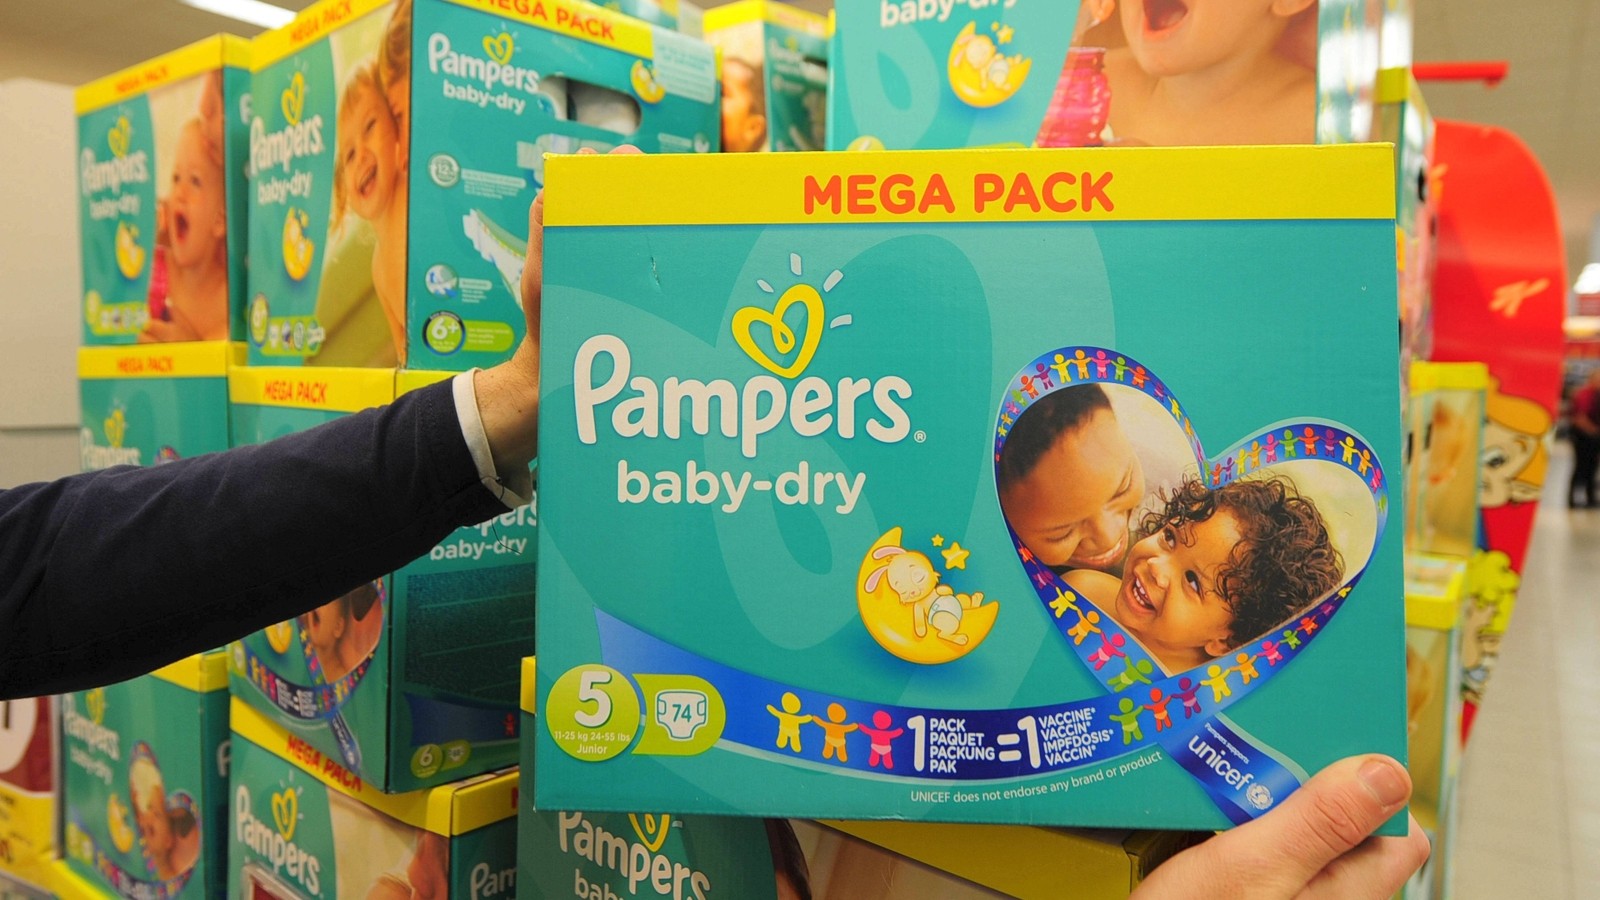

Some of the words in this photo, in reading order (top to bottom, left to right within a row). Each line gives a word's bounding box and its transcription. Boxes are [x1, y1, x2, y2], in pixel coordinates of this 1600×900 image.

[476, 0, 548, 21] EGA
[556, 8, 615, 41] PACK
[428, 32, 539, 94] Pampers
[443, 79, 525, 115] baby-dry
[250, 116, 323, 175] Pampers
[803, 173, 956, 215] MEGA
[973, 171, 1115, 213] PACK
[431, 317, 459, 340] 6+
[263, 380, 293, 401] MEGA
[296, 381, 327, 404] PACK
[573, 334, 912, 458] Pampers
[617, 459, 866, 514] baby-dry
[574, 671, 612, 728] 5
[672, 704, 692, 722] 74
[555, 731, 575, 741] 11-25
[577, 732, 588, 742] kg
[590, 732, 615, 742] 24-55
[617, 732, 631, 742] lbs
[907, 715, 926, 772] 1
[930, 718, 966, 733] PACK
[930, 733, 985, 747] PAQUET
[287, 735, 321, 770] MEGA
[322, 757, 363, 793] PACK
[576, 744, 608, 755] Junior
[930, 746, 995, 761] PACKUNG
[930, 759, 957, 774] PAK
[1188, 735, 1254, 791] unicef
[911, 791, 950, 803] UNICEF
[953, 792, 980, 803] does
[982, 790, 1001, 801] not
[1003, 785, 1048, 800] endorse
[1050, 781, 1069, 793] any
[1071, 769, 1104, 788] brand
[1106, 767, 1117, 778] or
[1119, 751, 1163, 776] product
[236, 785, 320, 896] Pampers
[558, 812, 711, 900] Pampers
